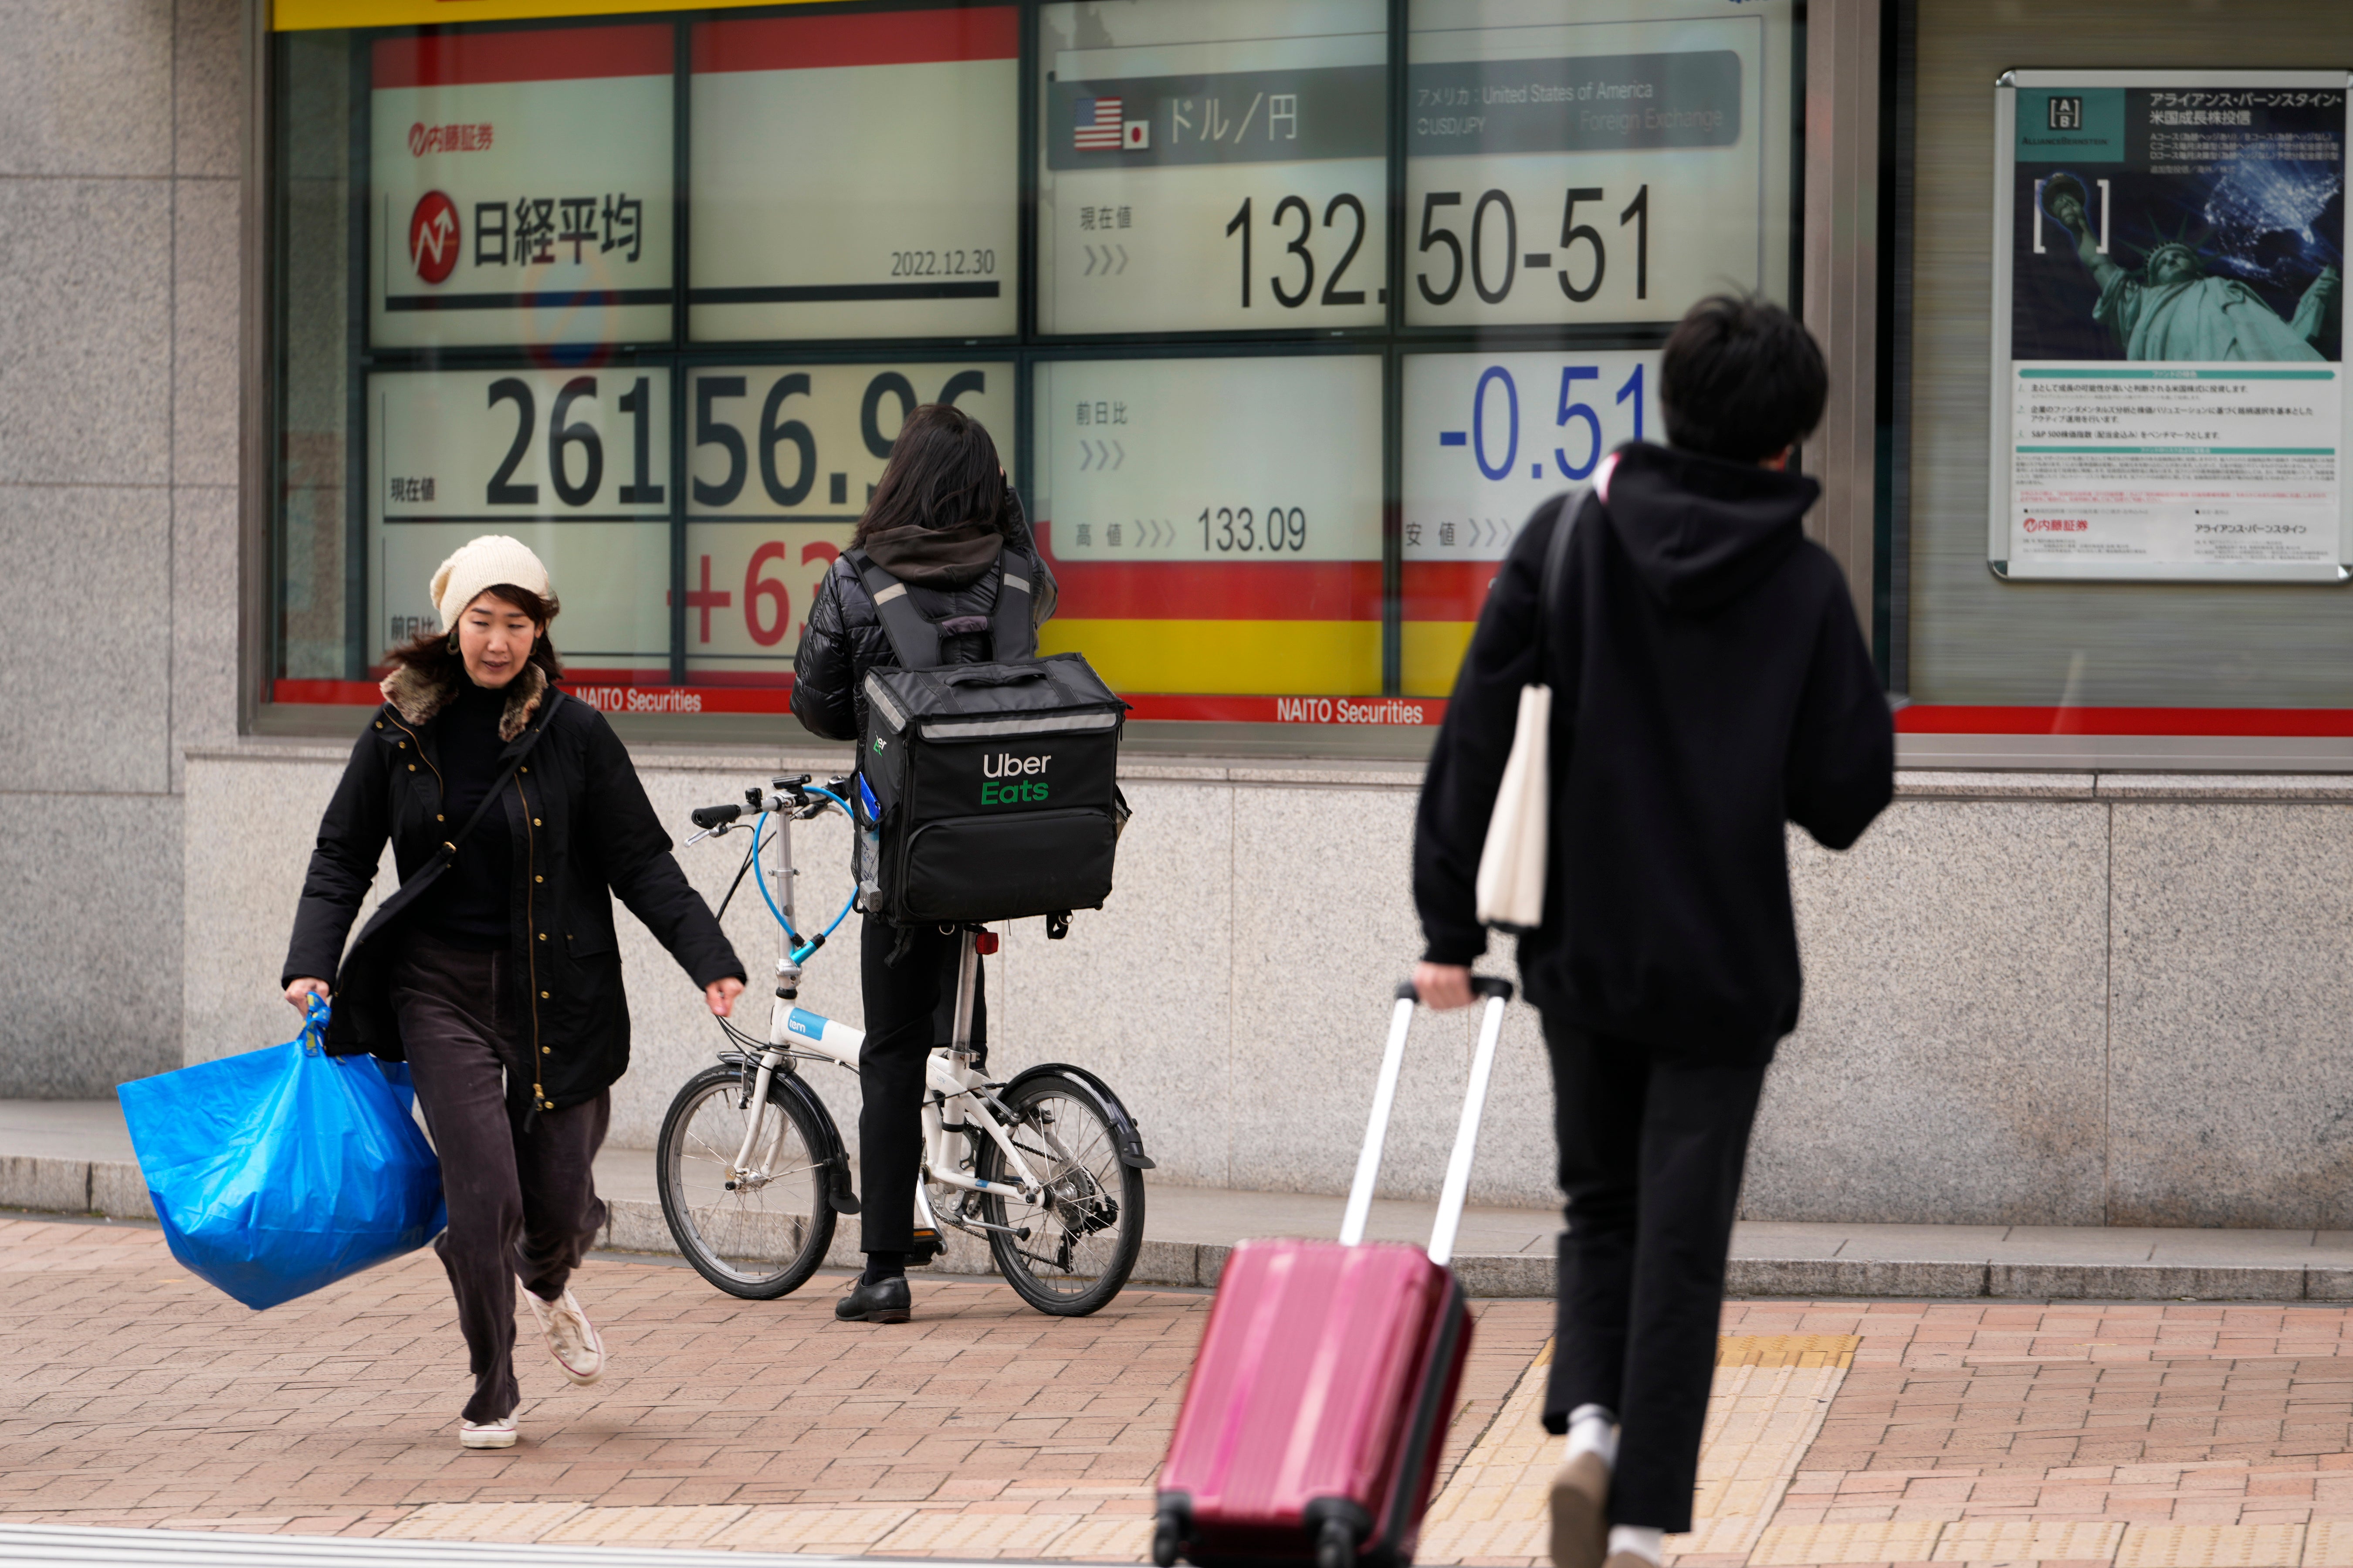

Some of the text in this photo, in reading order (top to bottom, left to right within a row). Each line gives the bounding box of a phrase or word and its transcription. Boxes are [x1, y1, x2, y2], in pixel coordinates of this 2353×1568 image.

[1482, 84, 1527, 104] United
[1530, 83, 1574, 102] States
[1577, 81, 1594, 101] of
[1596, 80, 1653, 99] America
[1579, 110, 1640, 134] Foreign
[2150, 110, 2251, 126] 米国成長株投信
[474, 193, 643, 267] 日経平均
[1080, 206, 1133, 231] 現在値
[891, 249, 995, 276] 2022.12.30
[1076, 401, 1129, 426] 前日比
[1440, 363, 1644, 481] -0.51
[390, 476, 436, 502] 現在値
[1198, 507, 1307, 552] 133.09
[2038, 520, 2088, 532] 内藤証券
[627, 688, 702, 712] Securities
[1277, 698, 1424, 724] NAITO Securities
[983, 753, 1052, 778] Uber
[981, 780, 1049, 805] Eats
